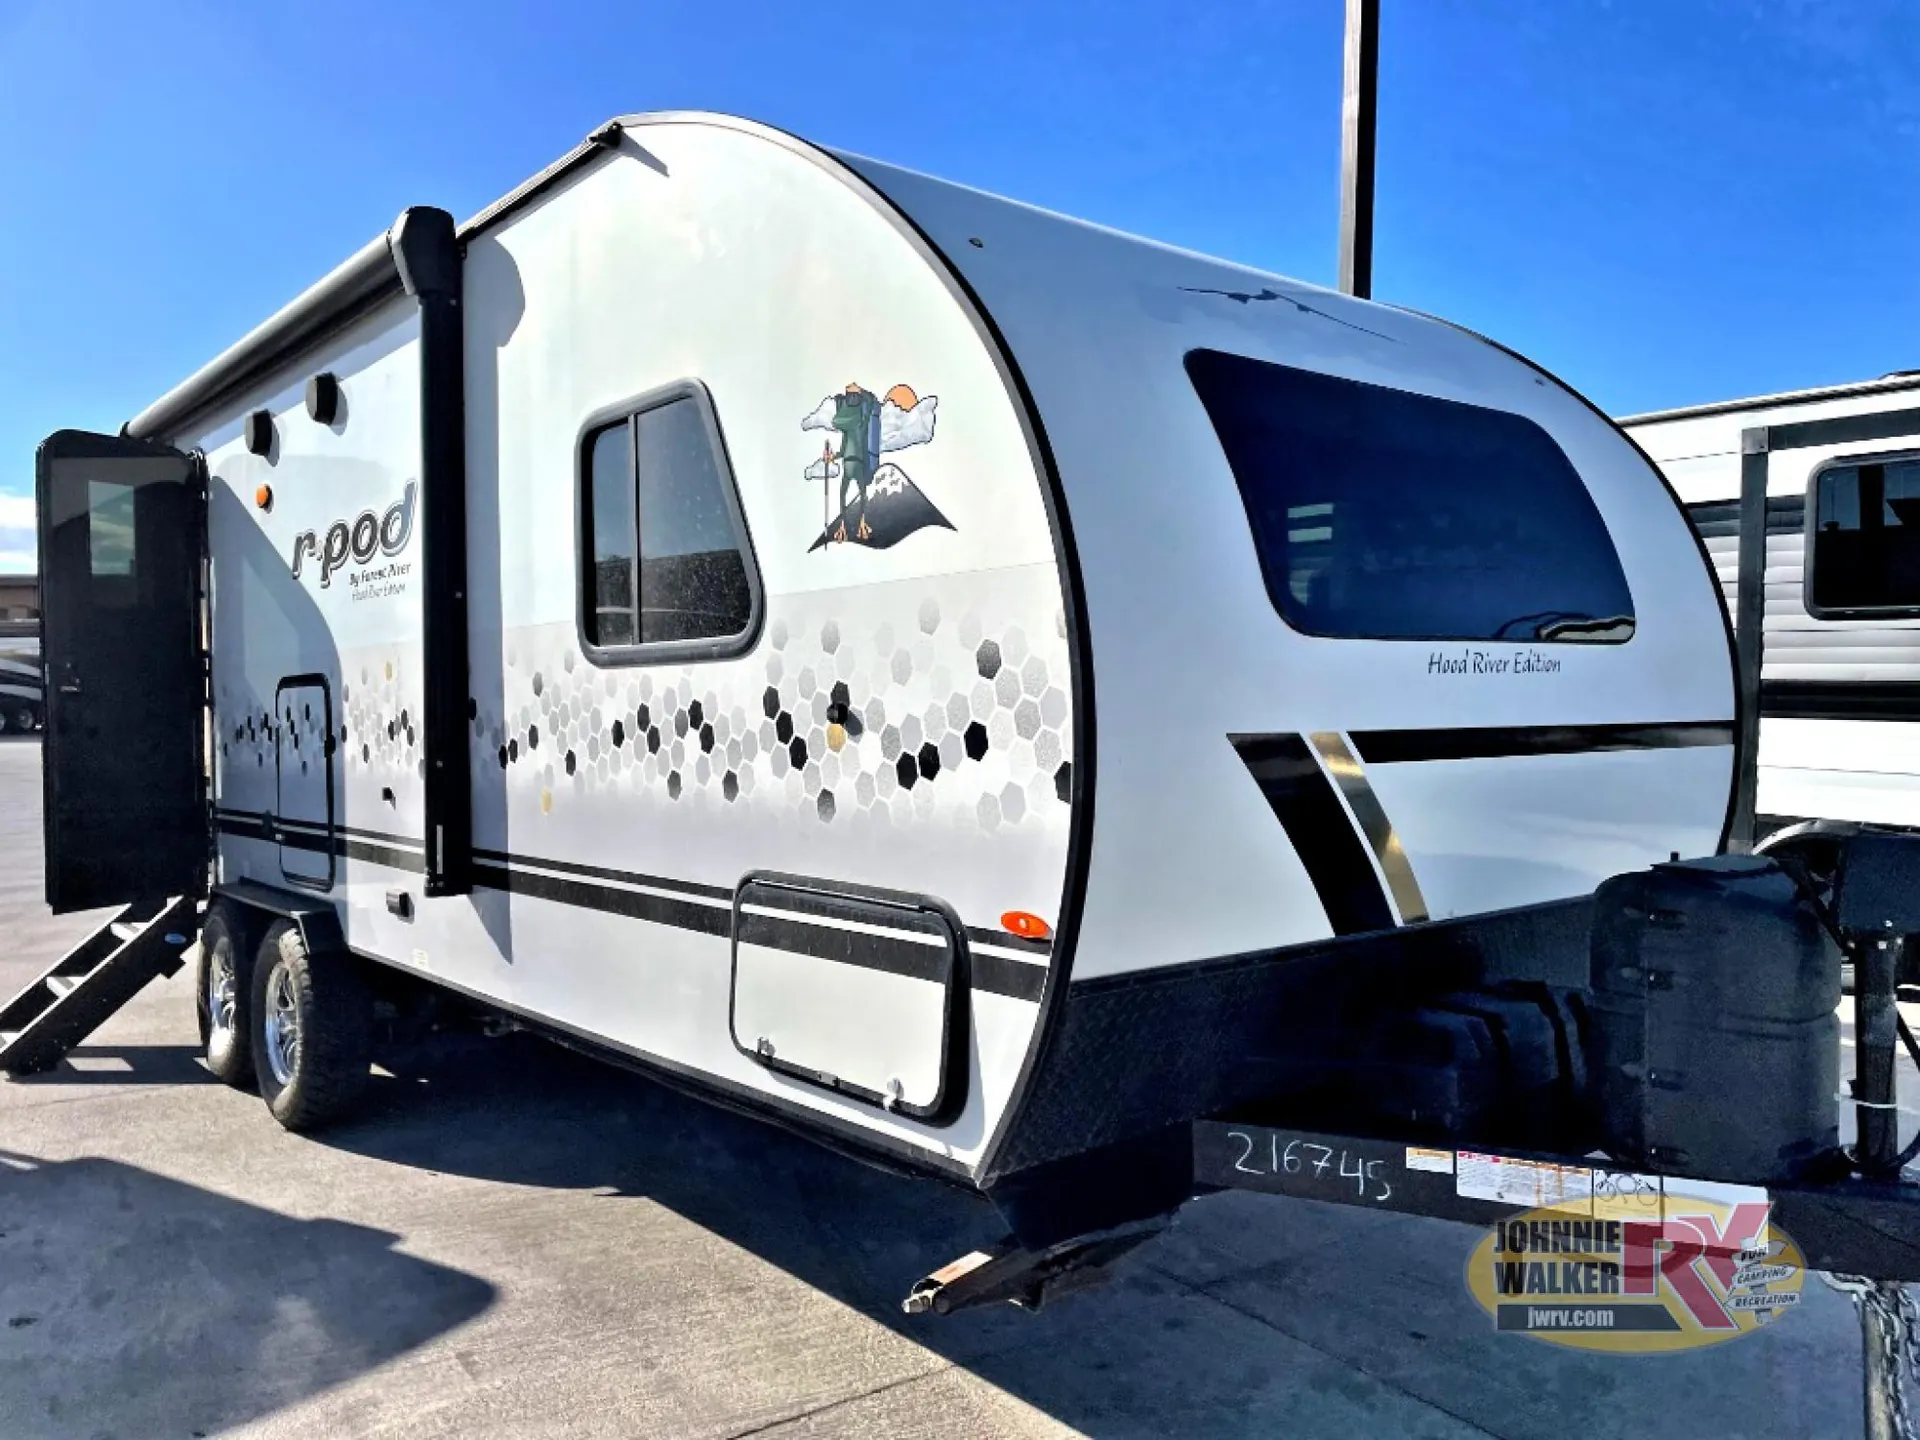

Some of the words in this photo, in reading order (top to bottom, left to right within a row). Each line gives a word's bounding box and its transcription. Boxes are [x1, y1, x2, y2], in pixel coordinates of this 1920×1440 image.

[1428, 648, 1469, 674] Hood
[1473, 652, 1510, 674] River
[1513, 648, 1561, 674] Edition
[1227, 1131, 1391, 1201] 216745
